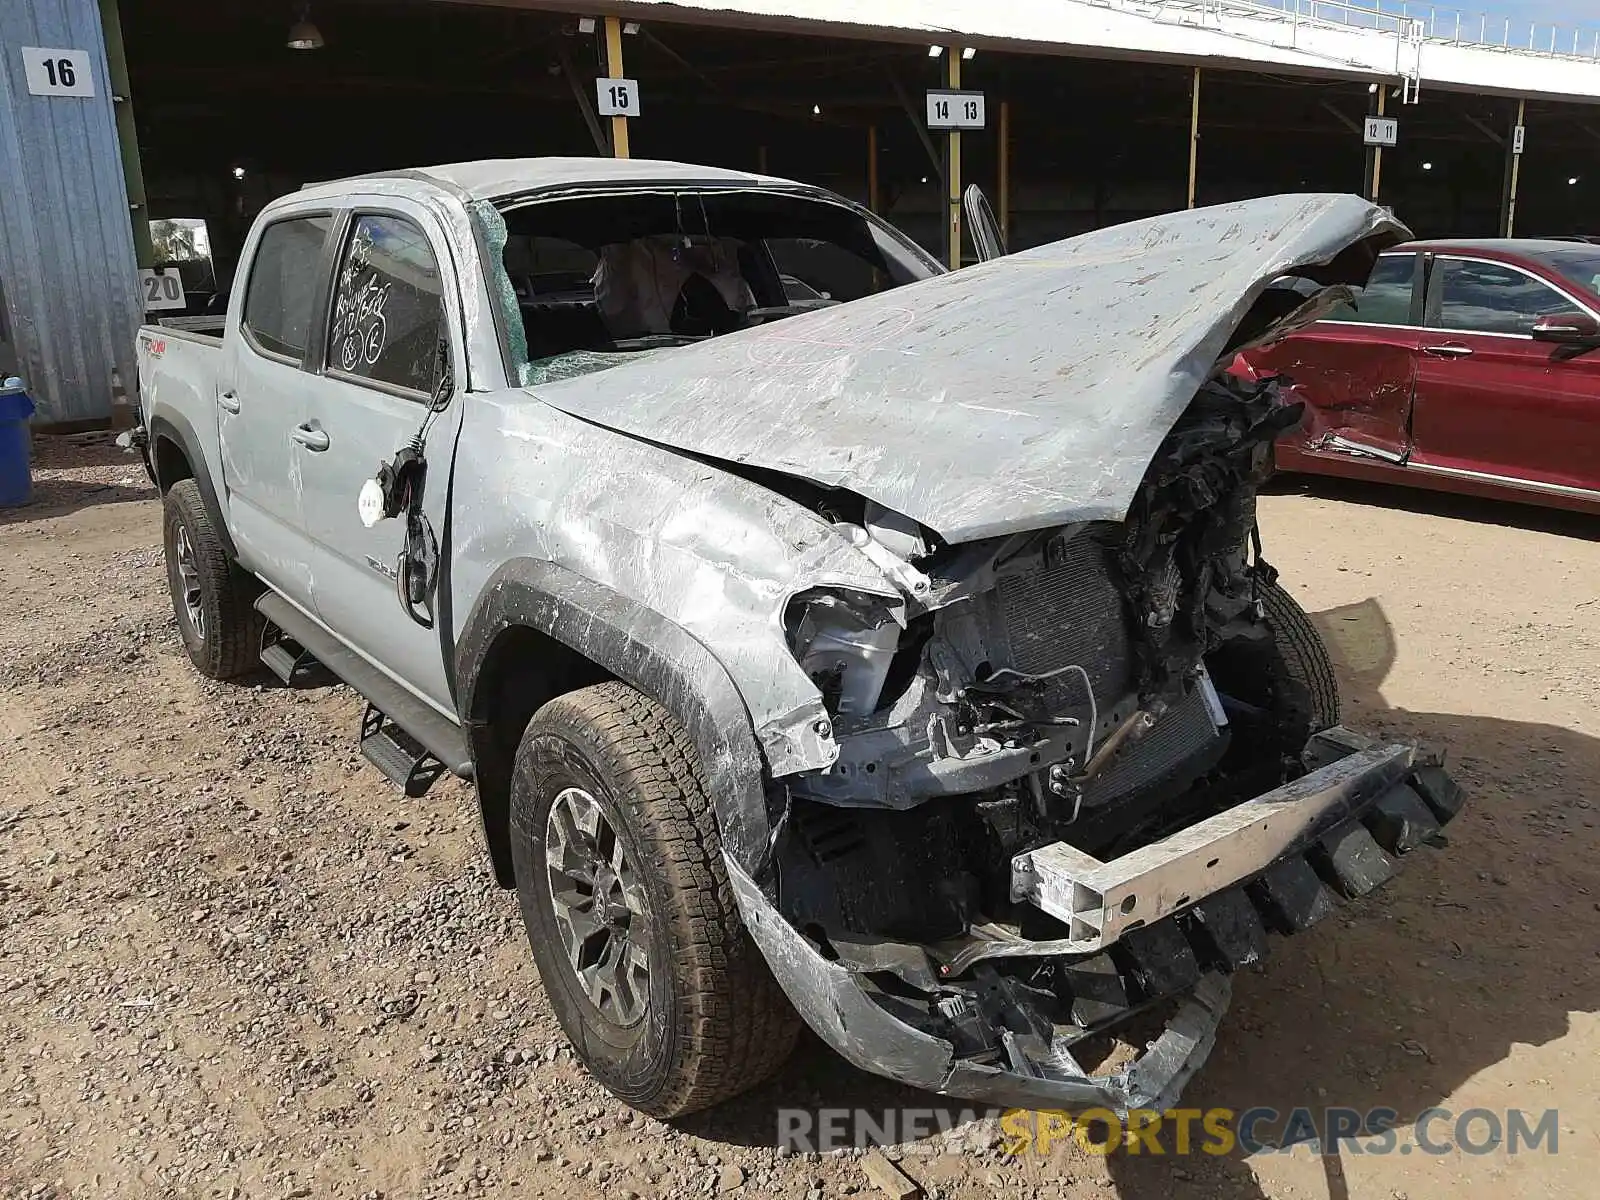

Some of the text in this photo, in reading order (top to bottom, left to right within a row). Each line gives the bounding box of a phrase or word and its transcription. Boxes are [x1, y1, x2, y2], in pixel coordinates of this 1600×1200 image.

[42, 58, 76, 87] 16
[609, 86, 629, 108] 15
[935, 101, 977, 120] 14 13
[1369, 123, 1394, 139] 12 11
[144, 276, 180, 302] 20
